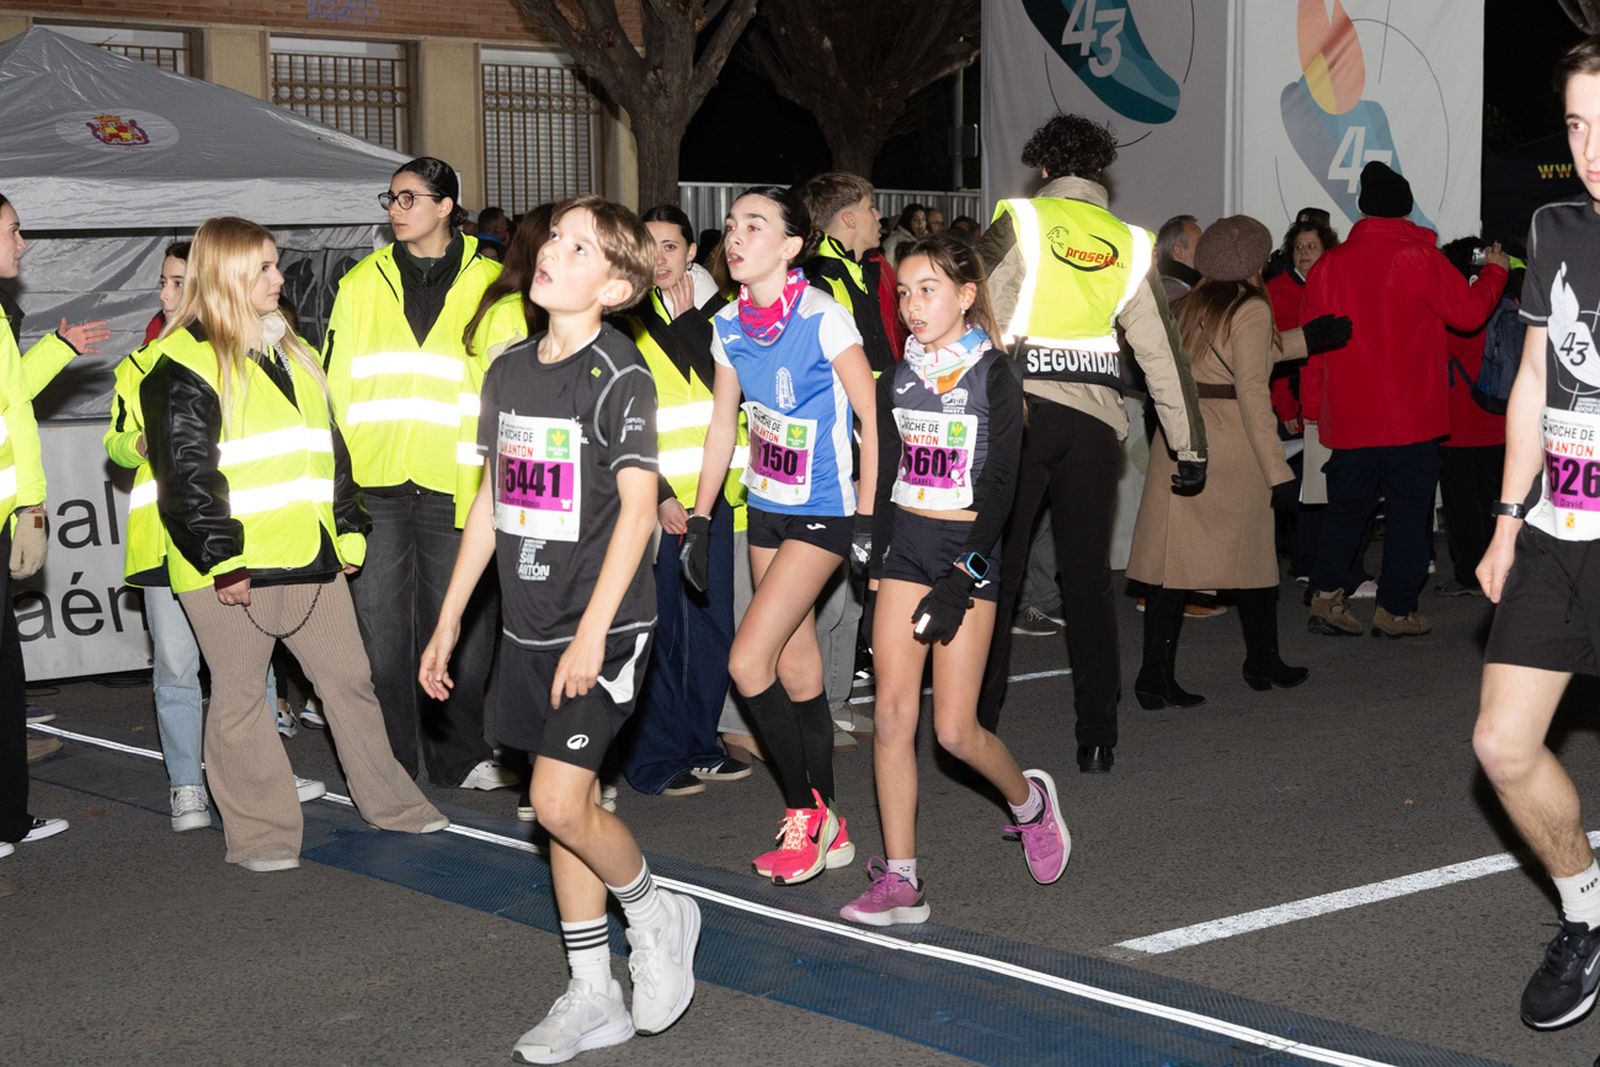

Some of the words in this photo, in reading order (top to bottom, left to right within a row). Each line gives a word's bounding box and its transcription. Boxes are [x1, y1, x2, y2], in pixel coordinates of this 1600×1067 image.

[1062, 0, 1126, 77] 43
[1559, 331, 1590, 367] 43
[523, 431, 534, 443] DE
[928, 423, 940, 433] DE
[1580, 429, 1595, 441] DE
[762, 443, 798, 476] 150
[505, 458, 561, 498] 5441
[13, 571, 149, 642] aén
